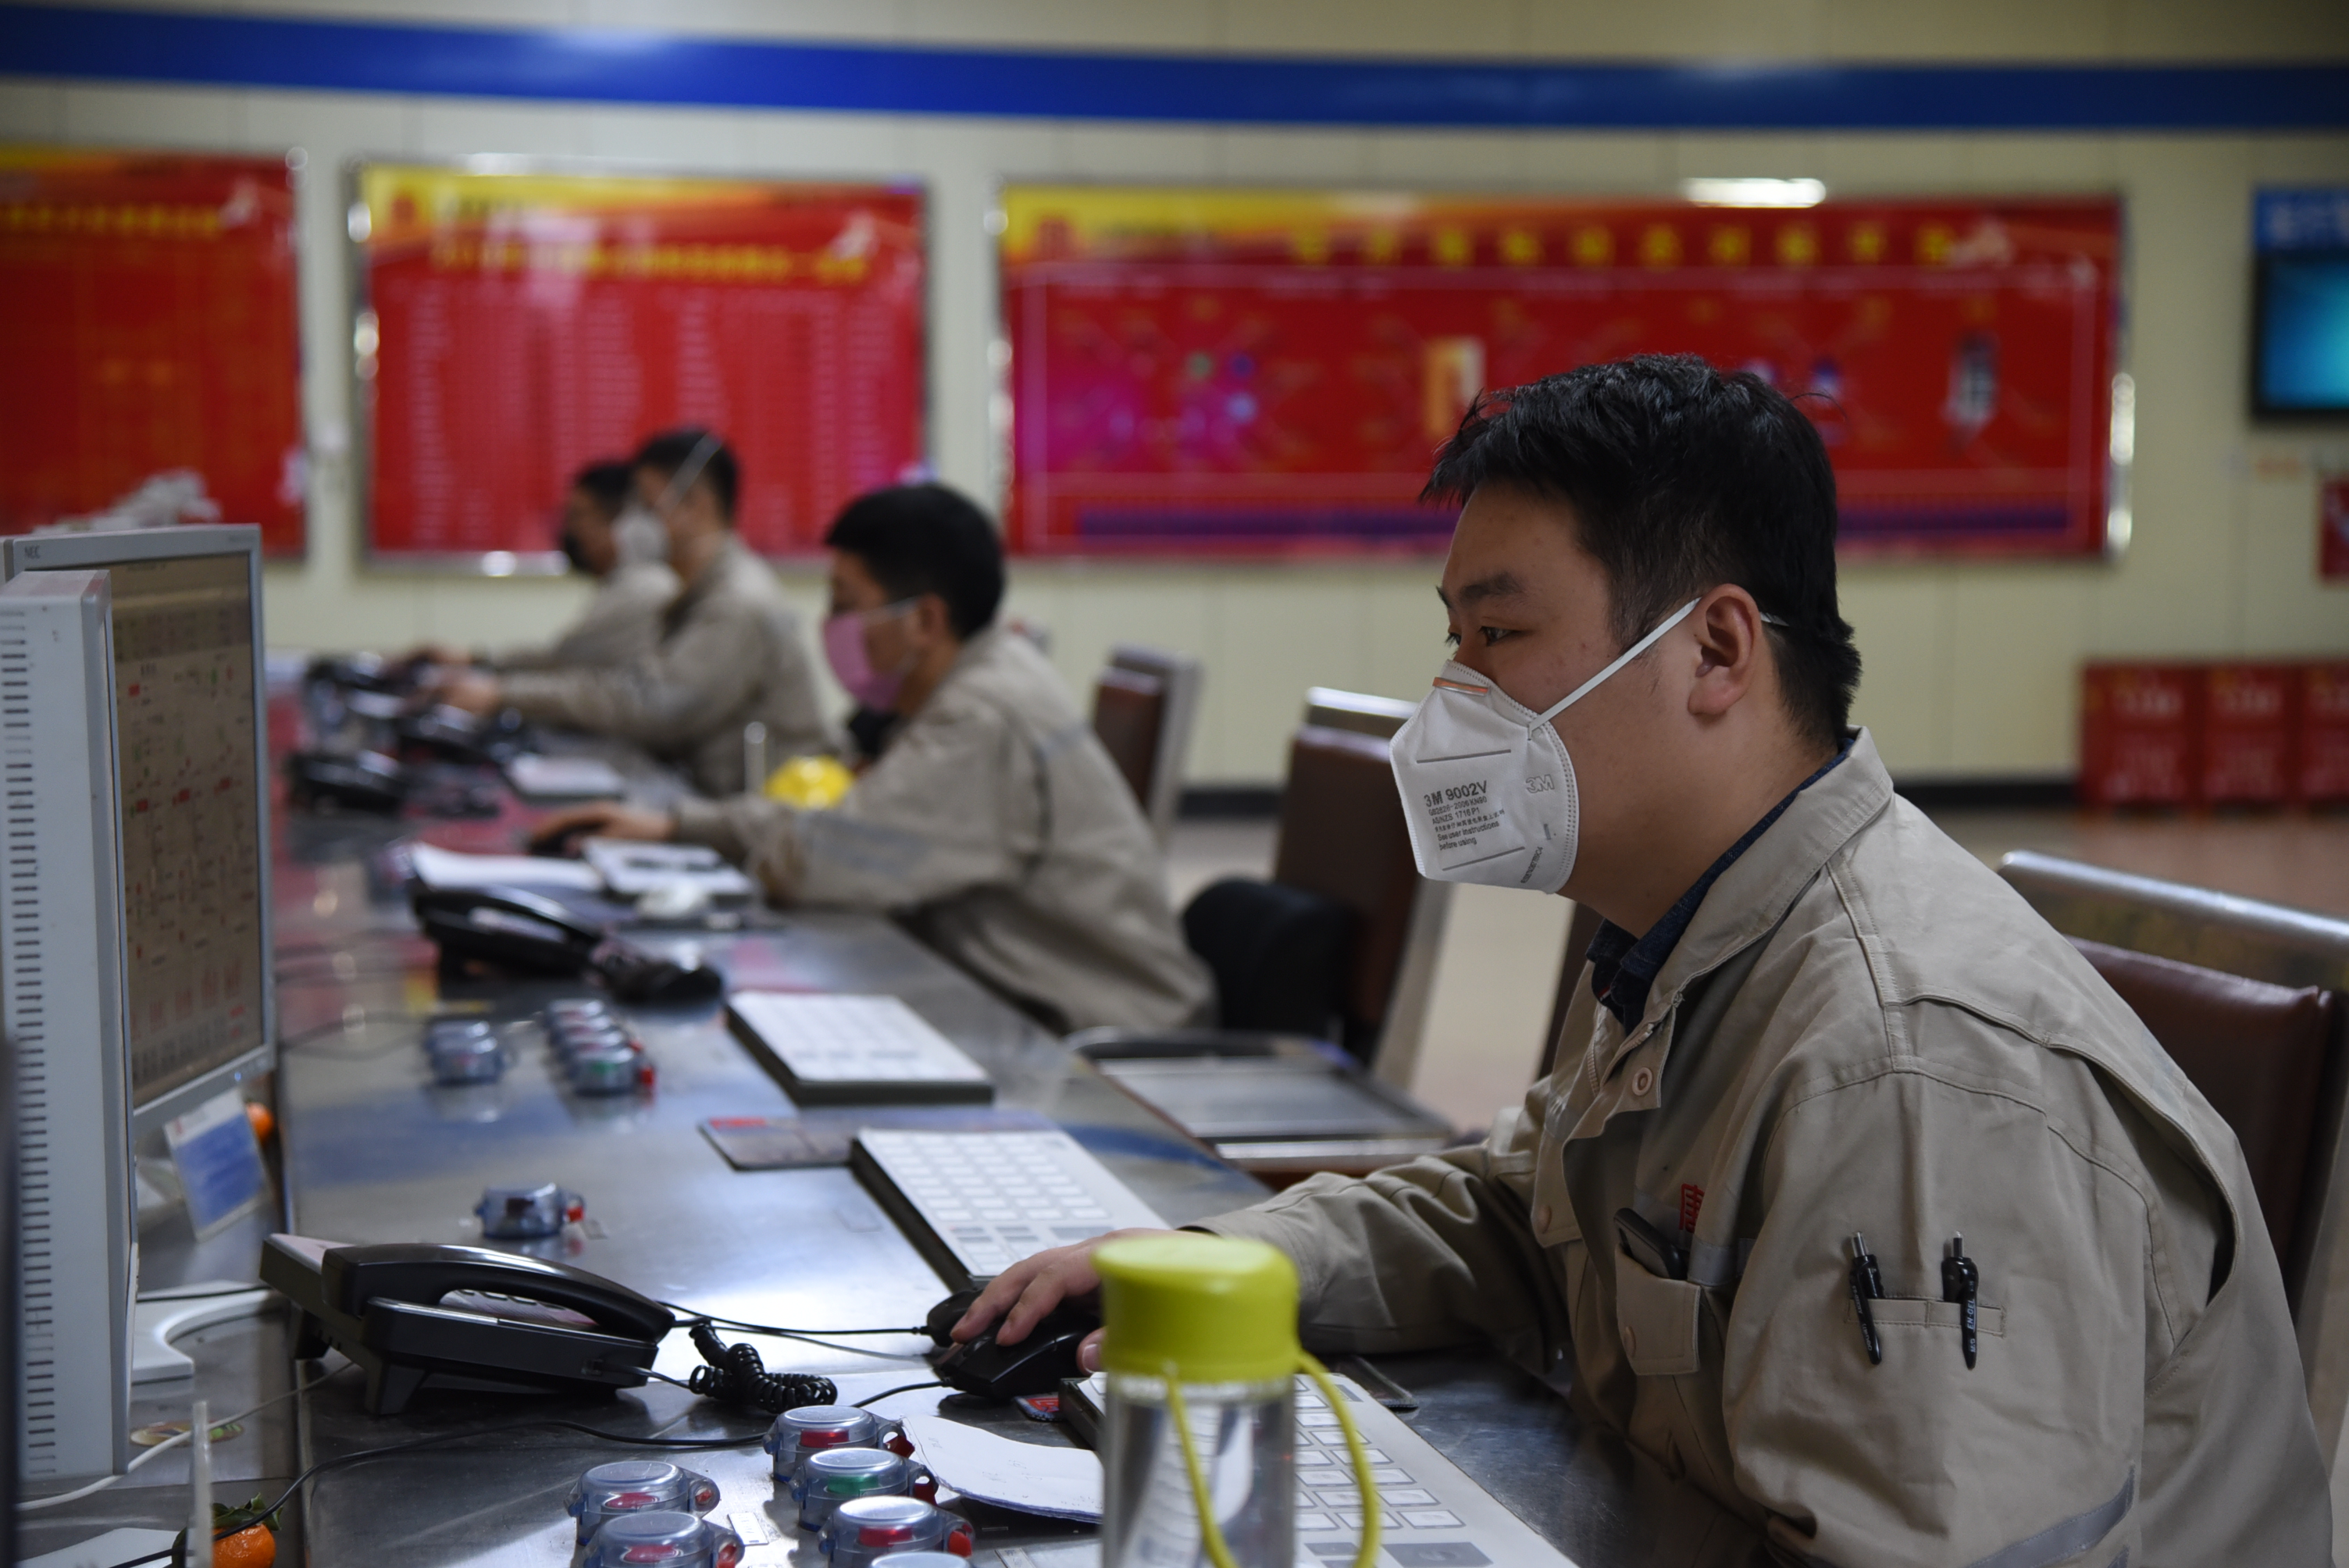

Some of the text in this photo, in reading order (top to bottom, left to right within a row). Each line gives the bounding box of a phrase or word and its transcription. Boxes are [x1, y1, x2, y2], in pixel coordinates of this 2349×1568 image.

[24, 545, 41, 559] NEC
[1526, 773, 1555, 794] 3M
[1424, 780, 1487, 807] 3M 9002V
[1455, 808, 1471, 818] 1716
[1471, 807, 1481, 815] P1
[1437, 833, 1449, 842] See
[1448, 830, 1462, 839] user
[1439, 836, 1477, 851] before using
